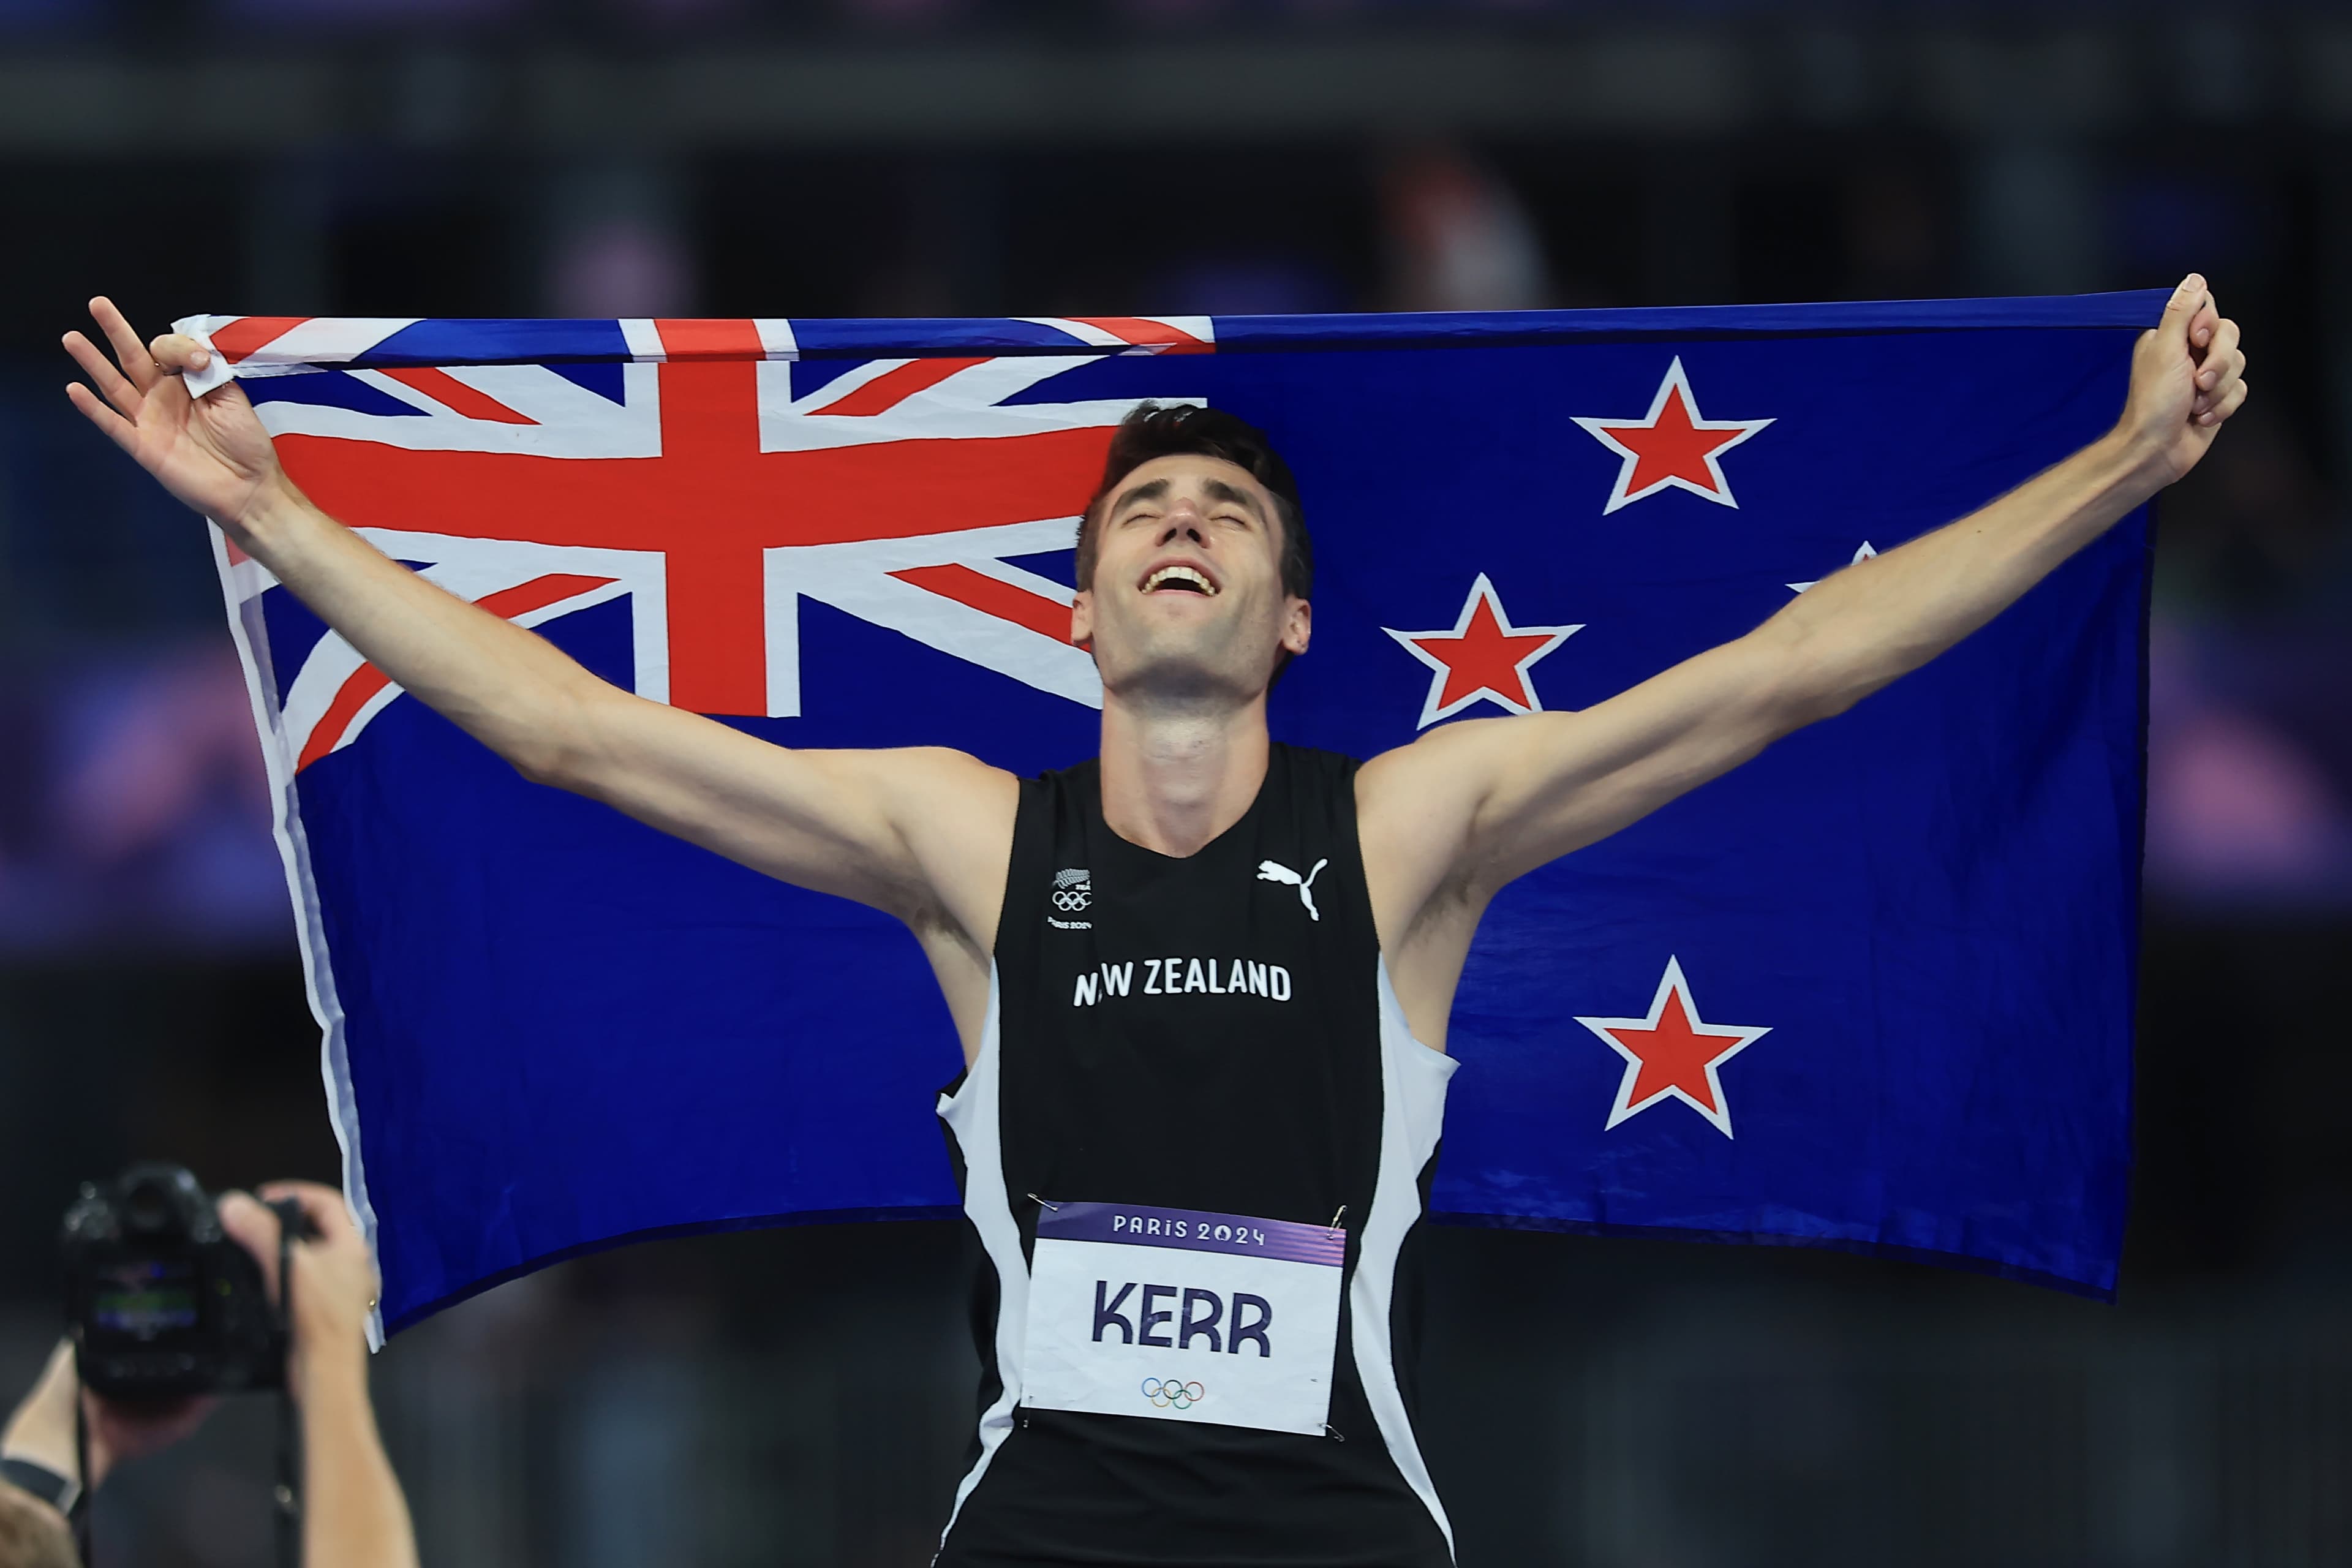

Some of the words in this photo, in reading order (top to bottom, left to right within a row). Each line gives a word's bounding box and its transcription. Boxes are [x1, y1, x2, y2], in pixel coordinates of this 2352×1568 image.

[1073, 961, 1134, 1007] NW
[1144, 958, 1291, 1001] ZEALAND
[1197, 1223, 1265, 1246] 2024
[1091, 1280, 1272, 1358] KERR
